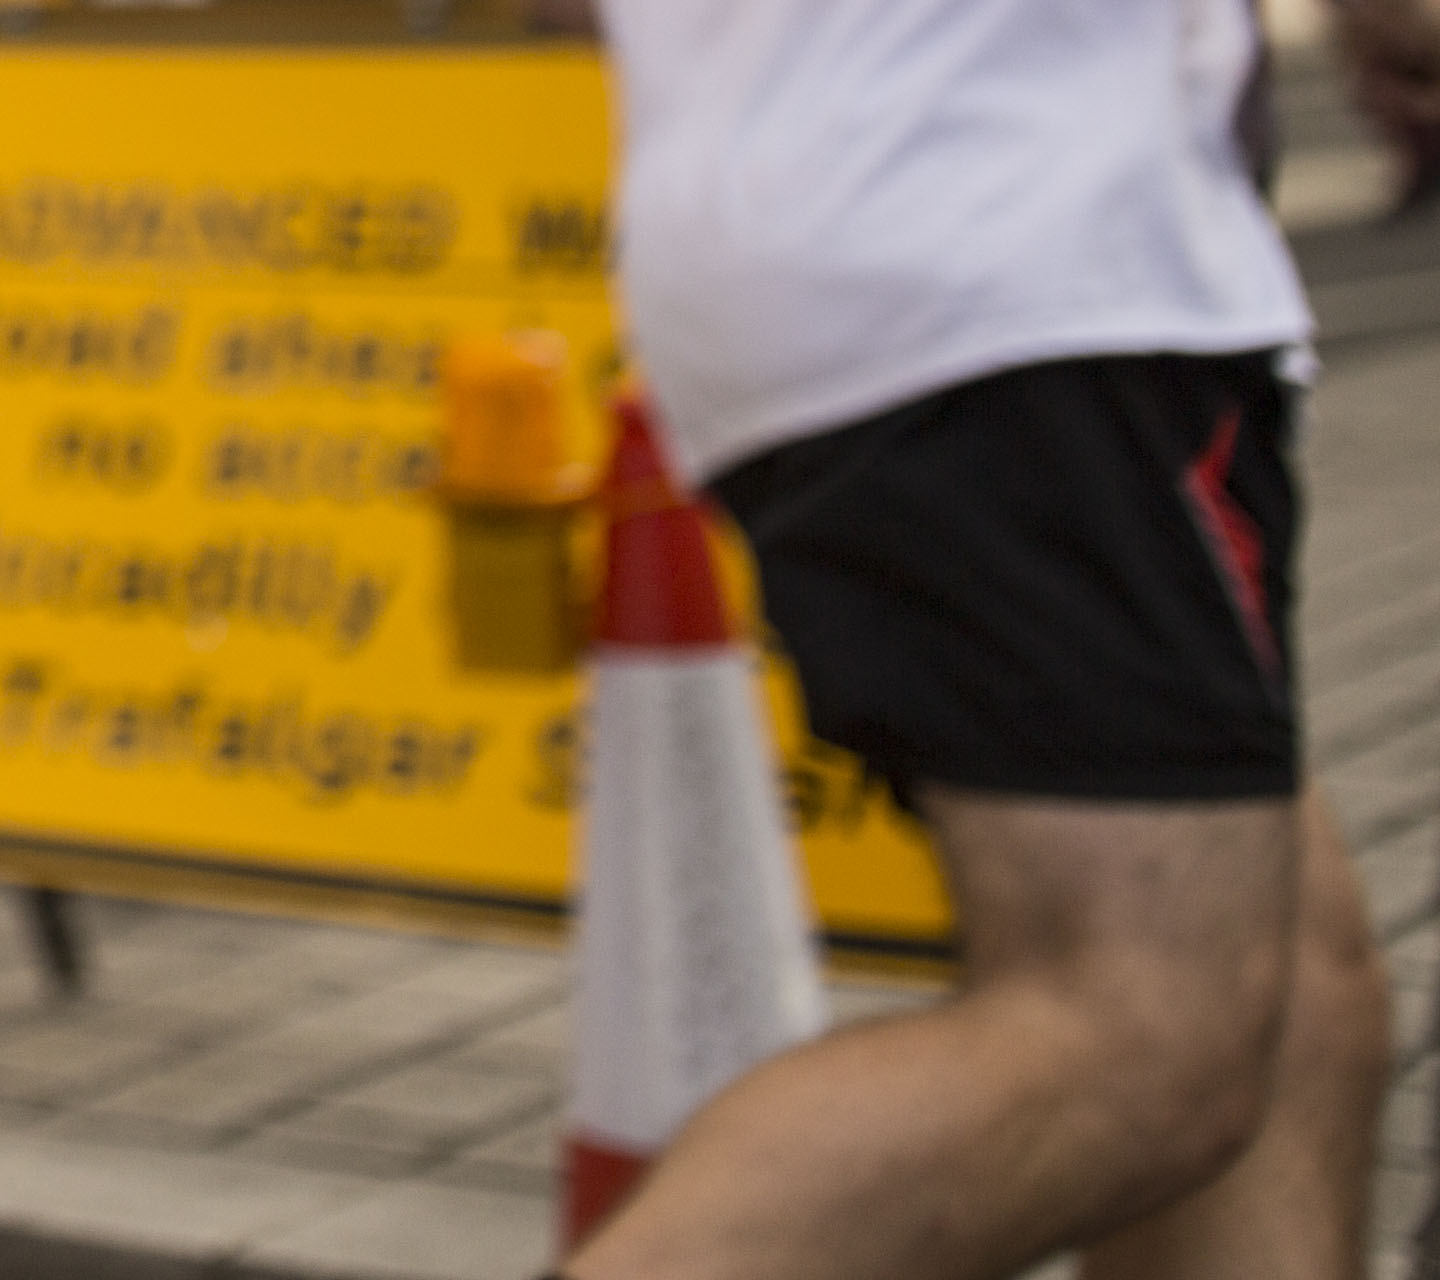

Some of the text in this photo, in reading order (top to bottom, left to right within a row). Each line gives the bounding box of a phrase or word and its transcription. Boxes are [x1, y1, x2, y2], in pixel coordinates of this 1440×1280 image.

[205, 308, 452, 395] ahea
[35, 415, 445, 504] no acce
